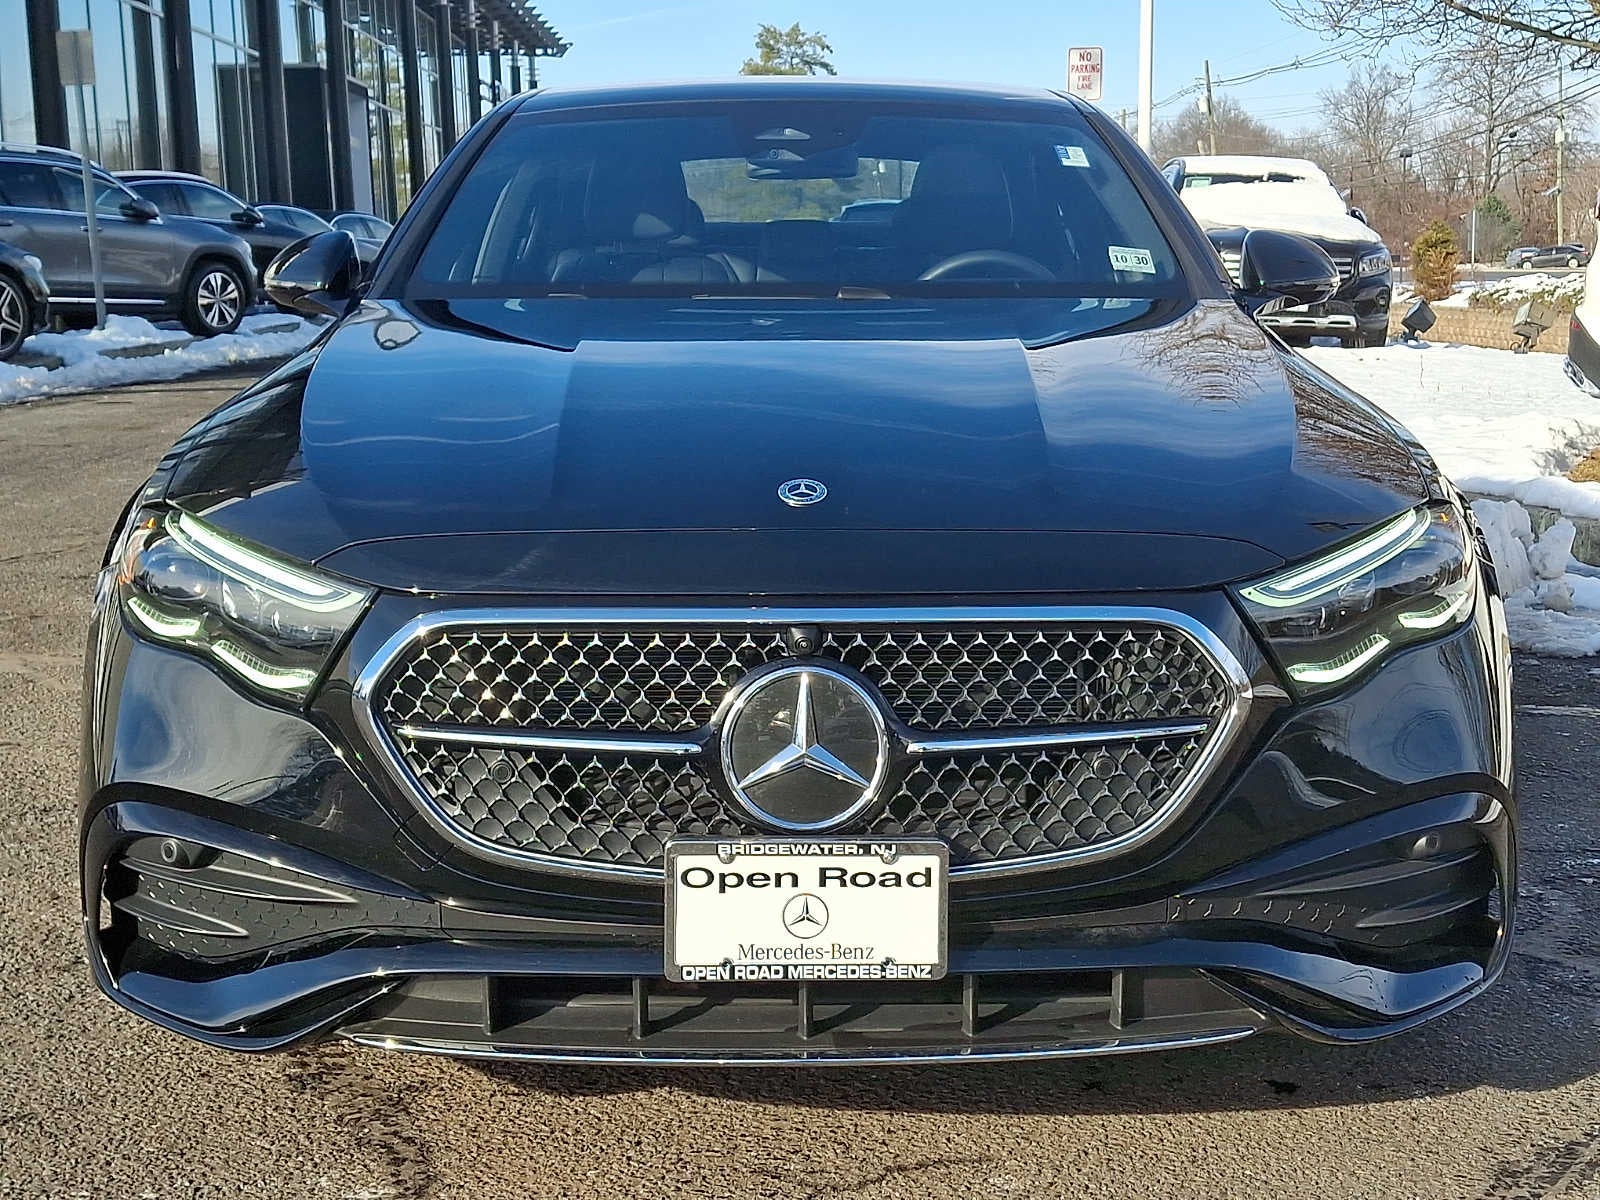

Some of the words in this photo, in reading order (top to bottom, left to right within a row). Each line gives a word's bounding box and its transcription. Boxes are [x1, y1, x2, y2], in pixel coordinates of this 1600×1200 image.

[1079, 52, 1092, 62] NO
[1071, 64, 1100, 73] PARKING
[1114, 254, 1128, 263] 10
[1134, 255, 1149, 266] 30
[870, 844, 897, 855] NJ
[680, 867, 799, 894] Open
[818, 867, 932, 888] Road
[738, 943, 875, 961] Mercedes-Benz
[682, 966, 730, 980] OPEN
[734, 965, 784, 979] ROAD
[787, 964, 932, 979] MERCEDES-BENZ
